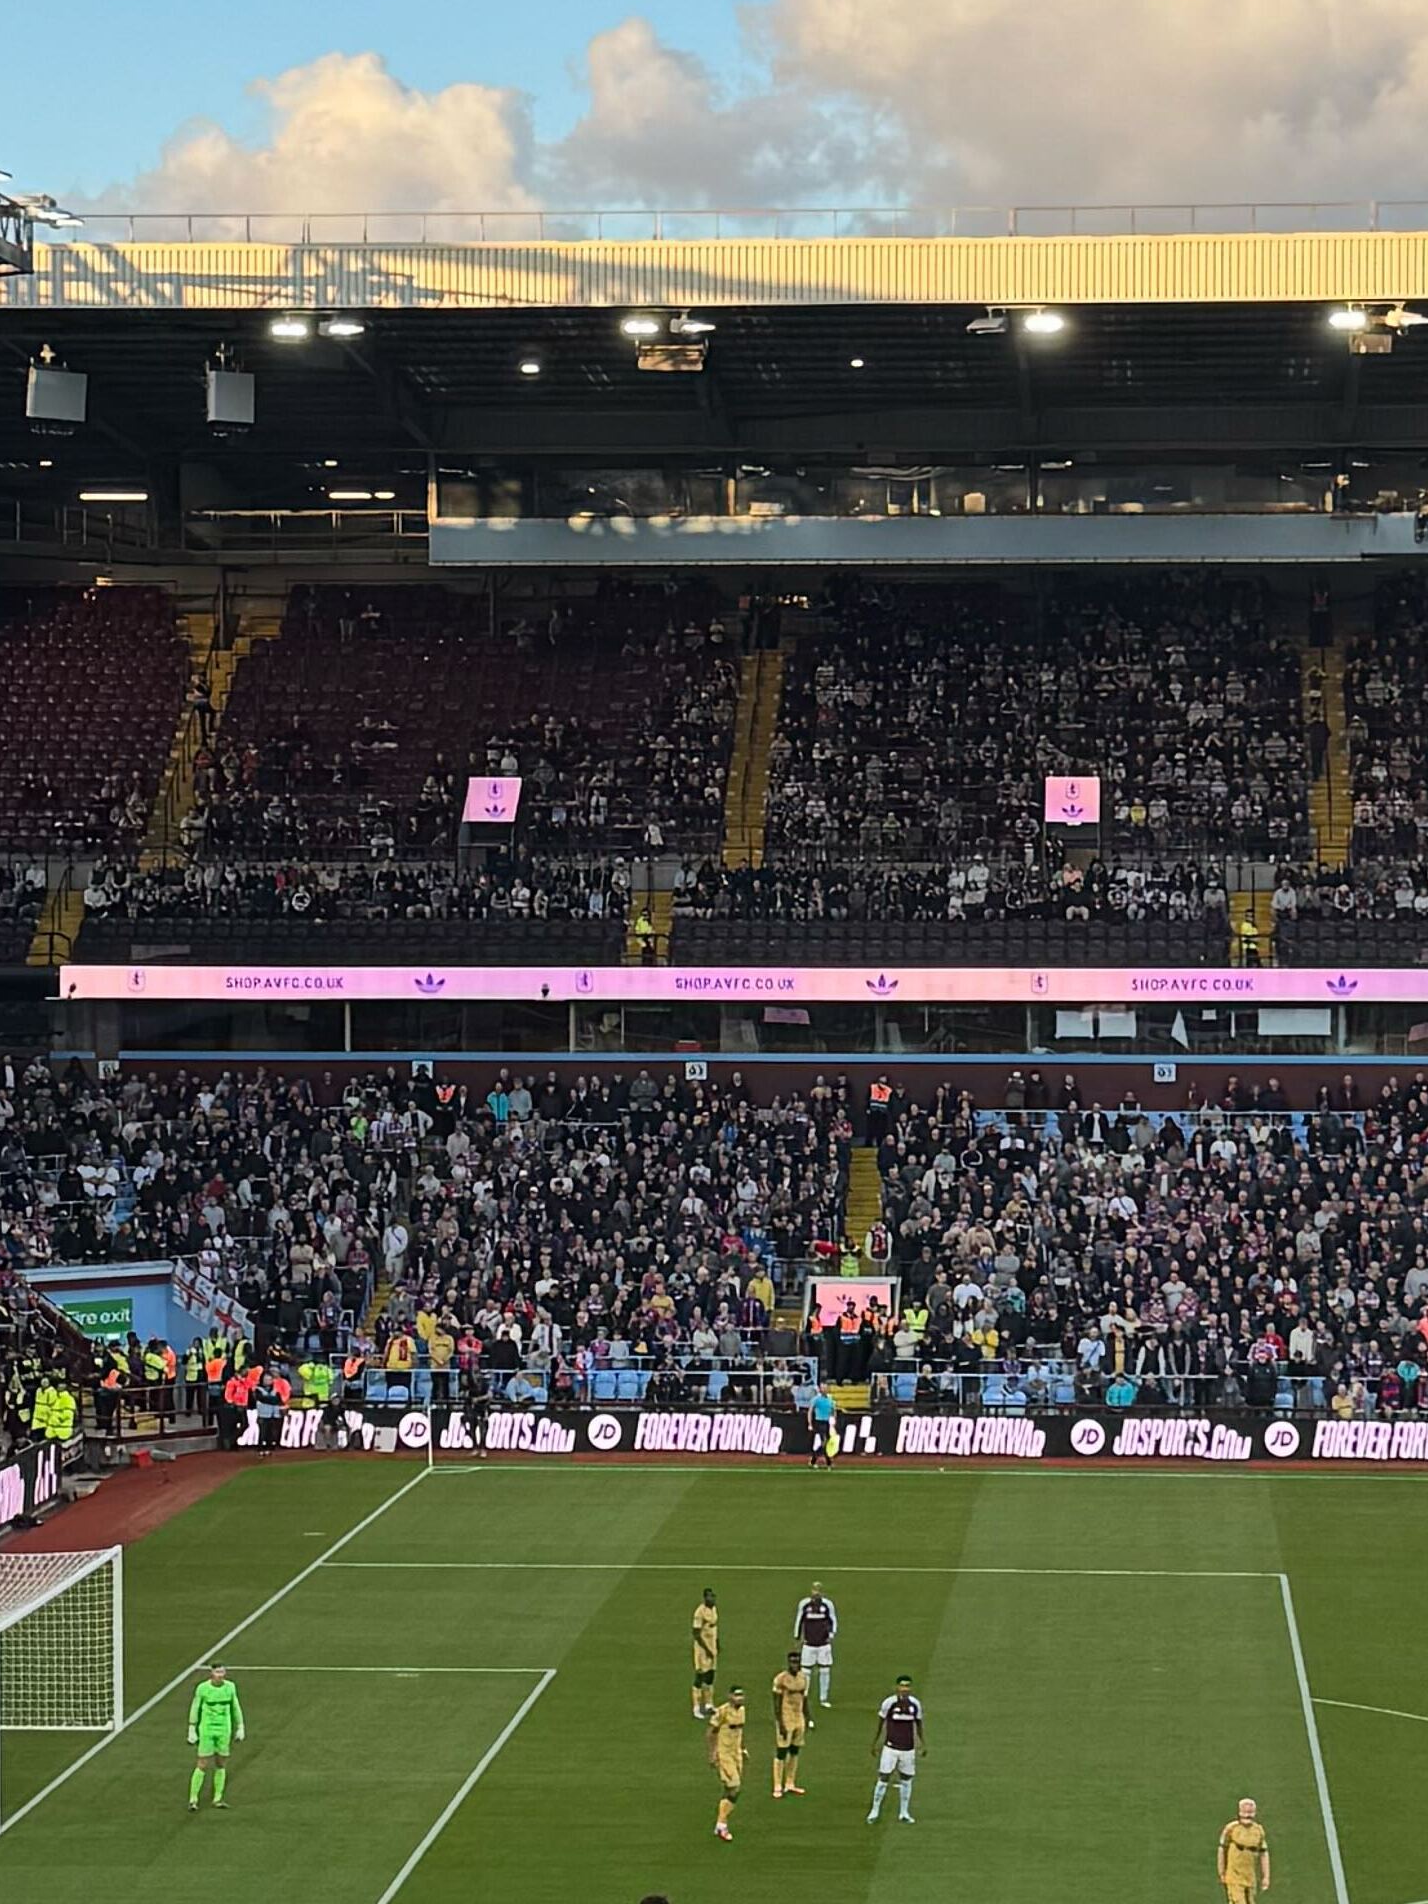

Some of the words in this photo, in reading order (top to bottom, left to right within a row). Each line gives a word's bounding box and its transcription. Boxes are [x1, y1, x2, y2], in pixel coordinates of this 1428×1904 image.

[100, 1308, 131, 1324] exit
[405, 1422, 427, 1437] JD
[594, 1423, 616, 1440] JD
[634, 1413, 712, 1452] FOREVER
[896, 1416, 973, 1456] FOREVER
[1078, 1428, 1100, 1444] JD
[1271, 1429, 1294, 1446] JD
[1312, 1420, 1390, 1460] FOREVER
